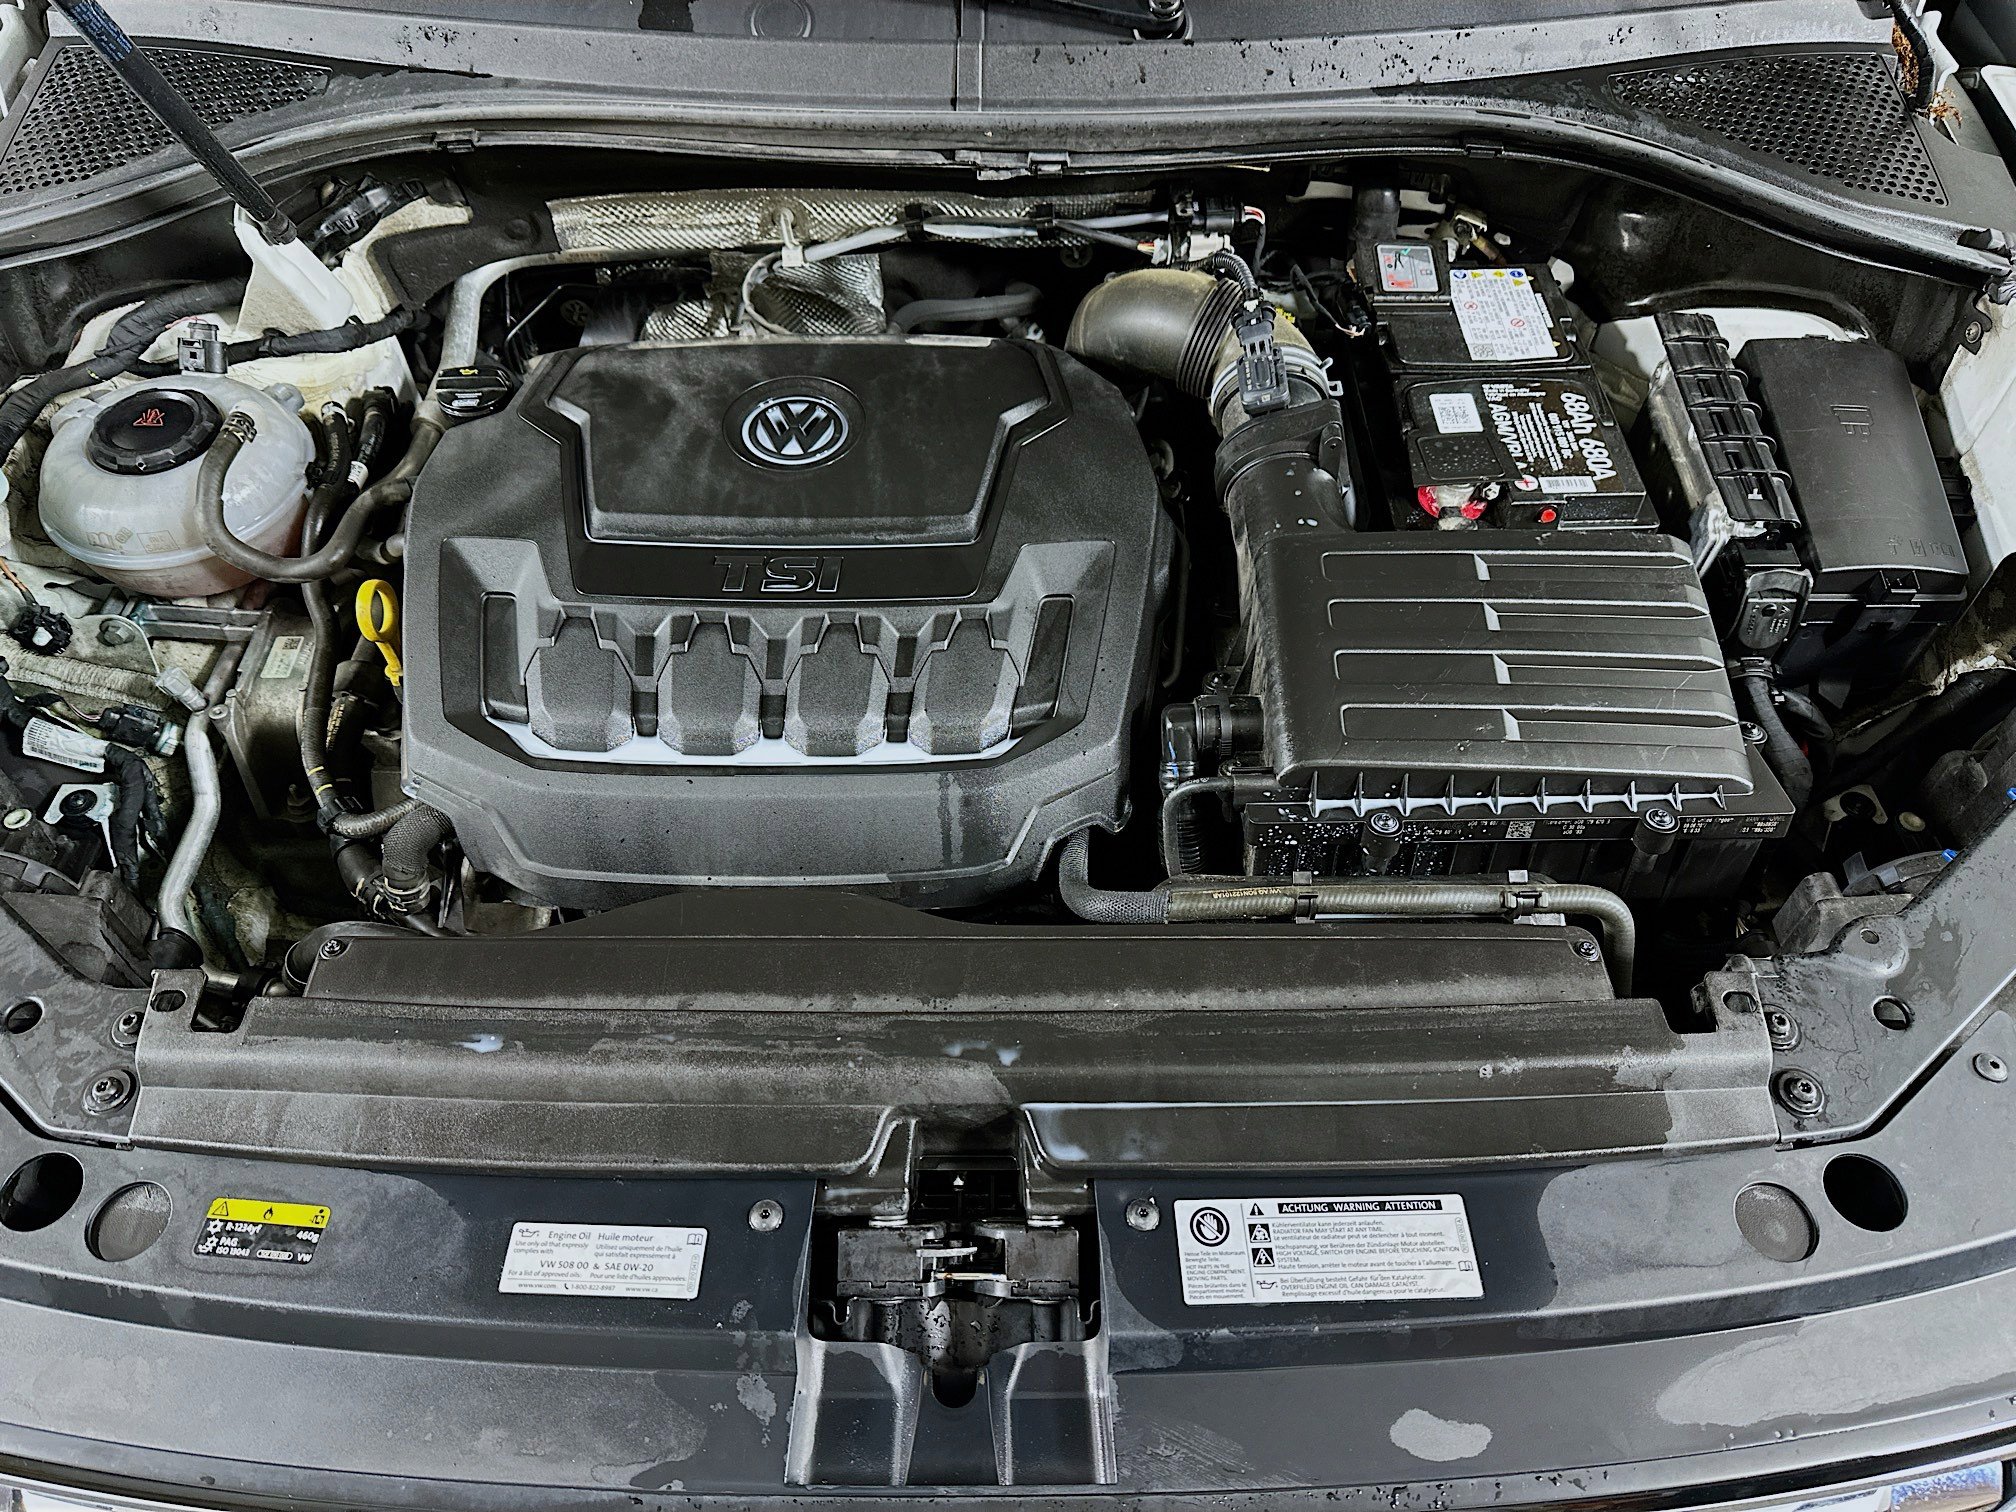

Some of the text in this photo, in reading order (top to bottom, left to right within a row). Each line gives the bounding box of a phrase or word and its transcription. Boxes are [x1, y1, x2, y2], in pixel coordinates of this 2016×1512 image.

[1561, 393, 1597, 434] 68Ah
[1578, 438, 1617, 481] 680A
[714, 555, 843, 592] TSI
[1282, 1201, 1436, 1213] ACHTUNG WARNING ATTENTION
[226, 1222, 262, 1235] R-1234yf
[220, 1237, 238, 1246] PAG
[548, 1231, 591, 1241] Engine Oil
[216, 1246, 230, 1254] ISO
[297, 1252, 312, 1262] VW
[540, 1260, 557, 1268] VW
[576, 1261, 589, 1269] 00
[623, 1263, 654, 1272] 0W-20
